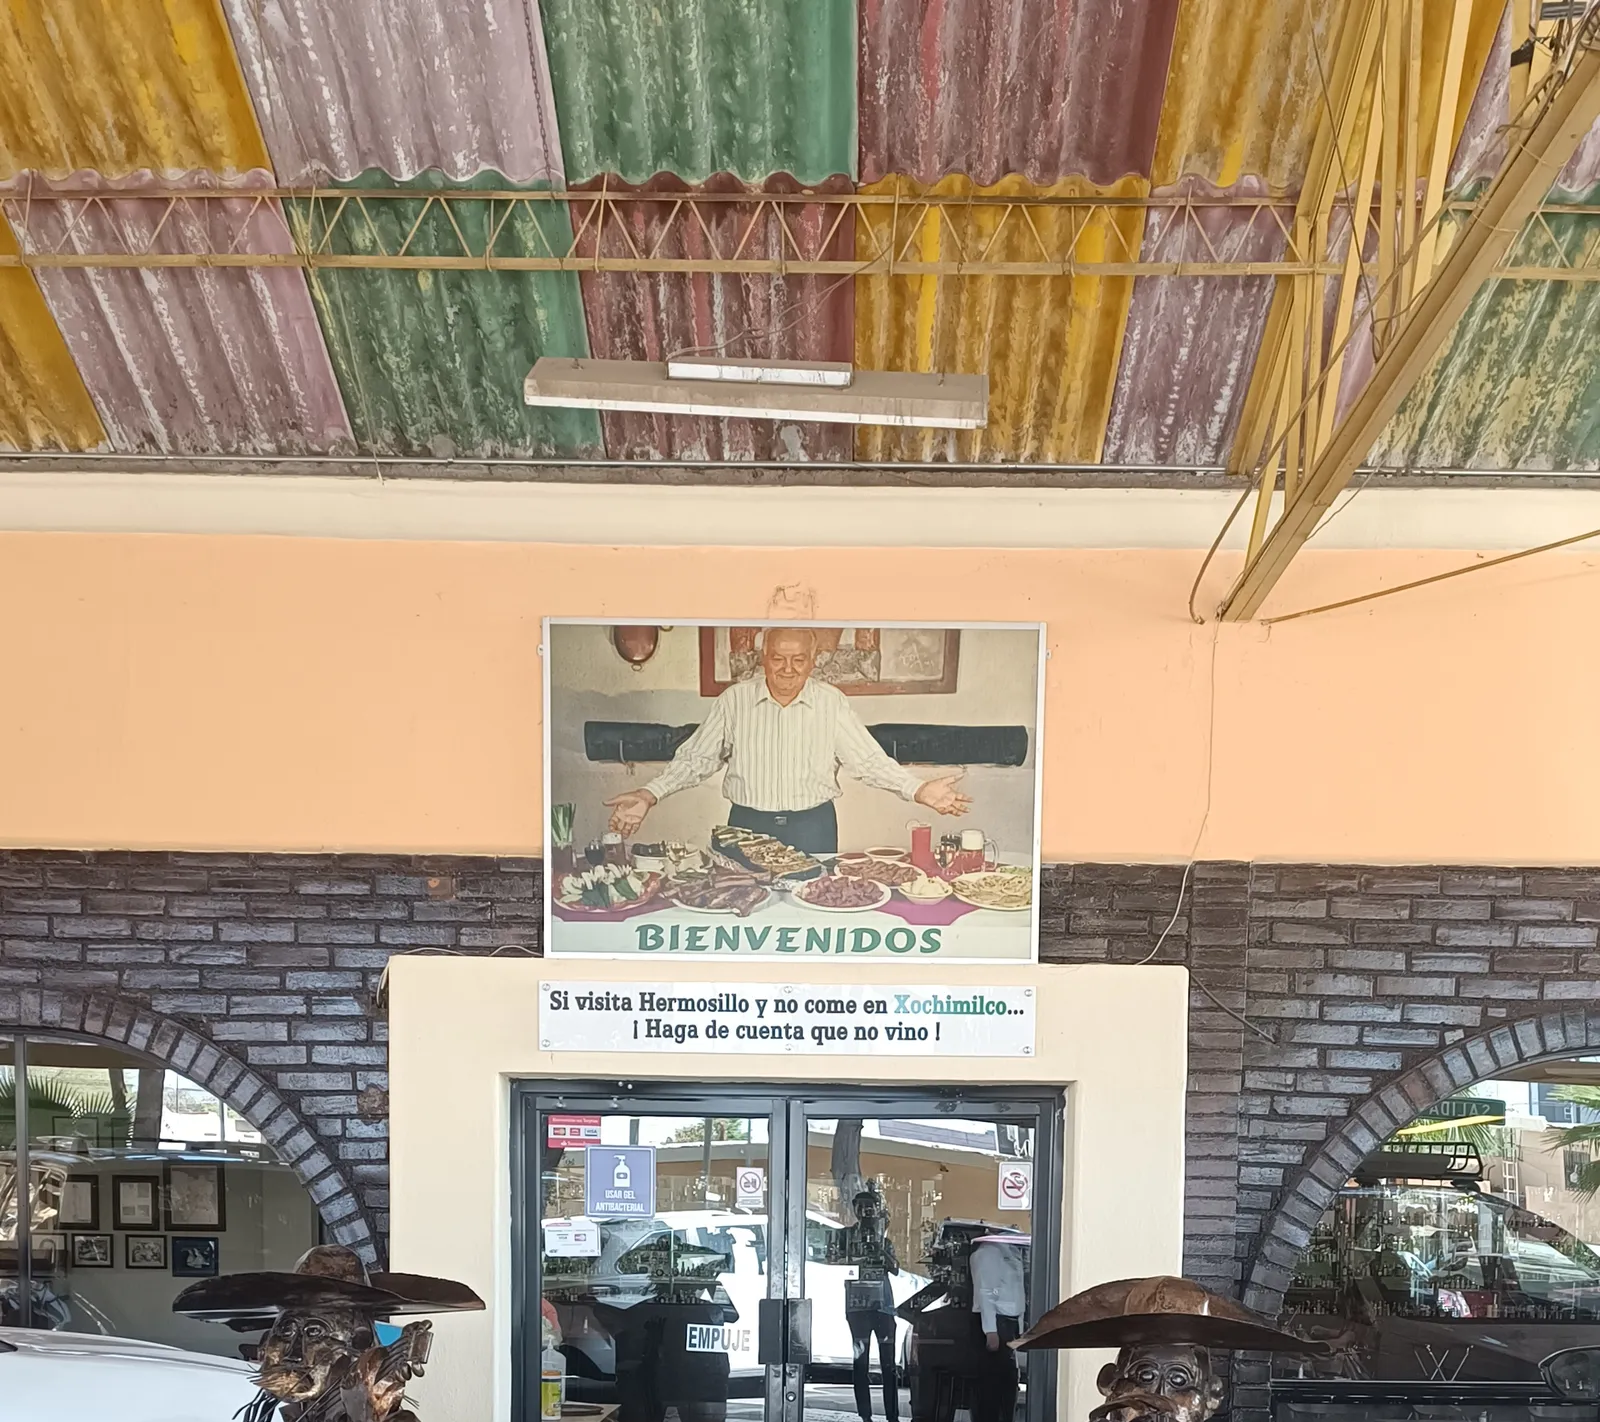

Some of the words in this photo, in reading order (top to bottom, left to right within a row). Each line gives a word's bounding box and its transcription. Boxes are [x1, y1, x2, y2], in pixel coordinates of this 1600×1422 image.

[635, 924, 942, 954] BIENVENIDOS
[550, 991, 570, 1012] Si
[575, 990, 633, 1012] visita
[639, 992, 750, 1014] Hermosillo
[754, 999, 768, 1018] y
[773, 998, 798, 1014] no
[804, 998, 857, 1015] come
[863, 999, 888, 1015] en
[894, 994, 1024, 1016] Xochimilco...
[645, 1020, 699, 1043] Haga
[705, 1021, 729, 1040] de
[735, 1022, 804, 1041] cuenta
[810, 1025, 848, 1045] que
[854, 1025, 879, 1042] no
[884, 1021, 928, 1042] vino
[595, 1202, 645, 1213] ANTIBACTERIAL
[604, 1190, 622, 1199] USAR
[623, 1190, 636, 1200] GEL
[688, 1326, 750, 1351] EMPUJE
